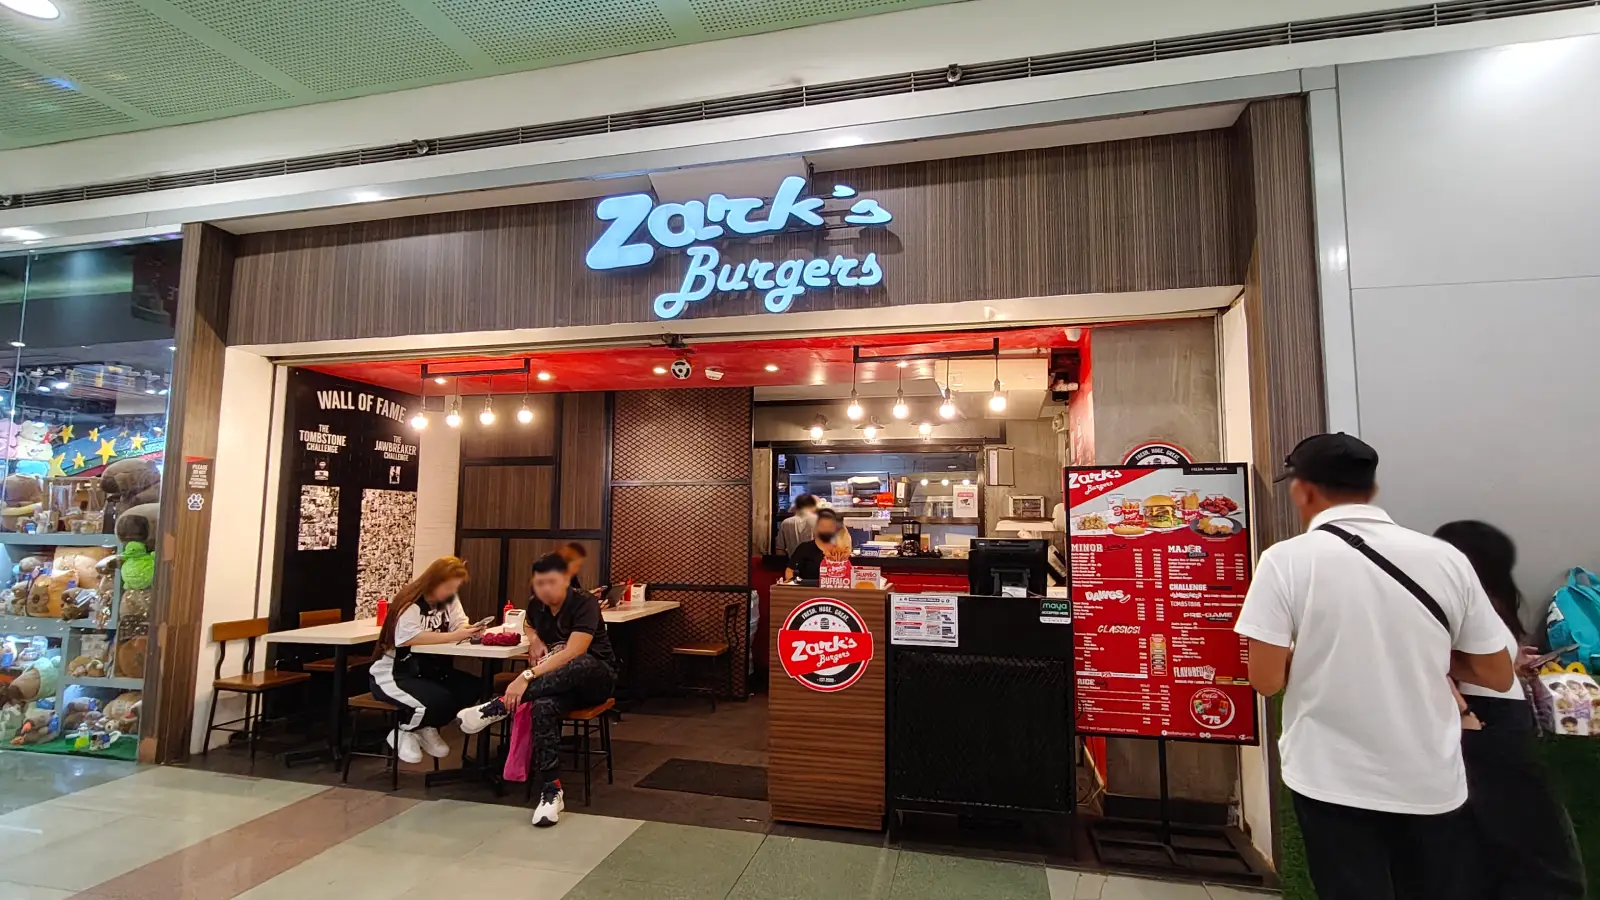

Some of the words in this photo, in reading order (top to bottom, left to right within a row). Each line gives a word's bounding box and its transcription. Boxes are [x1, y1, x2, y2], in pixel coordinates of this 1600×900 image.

[585, 175, 893, 270] Zark's
[653, 246, 883, 320] Burgers
[316, 390, 355, 410] WALL
[358, 392, 374, 412] OF
[375, 397, 407, 424] FAME
[318, 423, 330, 434] THE
[298, 429, 347, 447] TOMBSTONE
[392, 435, 402, 443] THE
[306, 442, 339, 454] CHALLENGE
[374, 440, 417, 456] JAWBREAKER
[383, 451, 409, 462] CHALLENGE
[1069, 469, 1123, 489] Zark's
[1084, 480, 1114, 496] Burgers
[1071, 543, 1103, 552] MINOR
[1168, 544, 1202, 553] MAJOR
[820, 576, 851, 586] BUFFALO
[1169, 583, 1207, 591] CHALLENGE
[1085, 590, 1125, 602] DAWGS
[801, 608, 818, 620] FRESH.
[818, 605, 833, 614] HUGE.
[834, 607, 849, 622] GREAT.
[1042, 602, 1068, 611] maya
[790, 635, 858, 662] Zark's
[816, 650, 851, 668] Burgers
